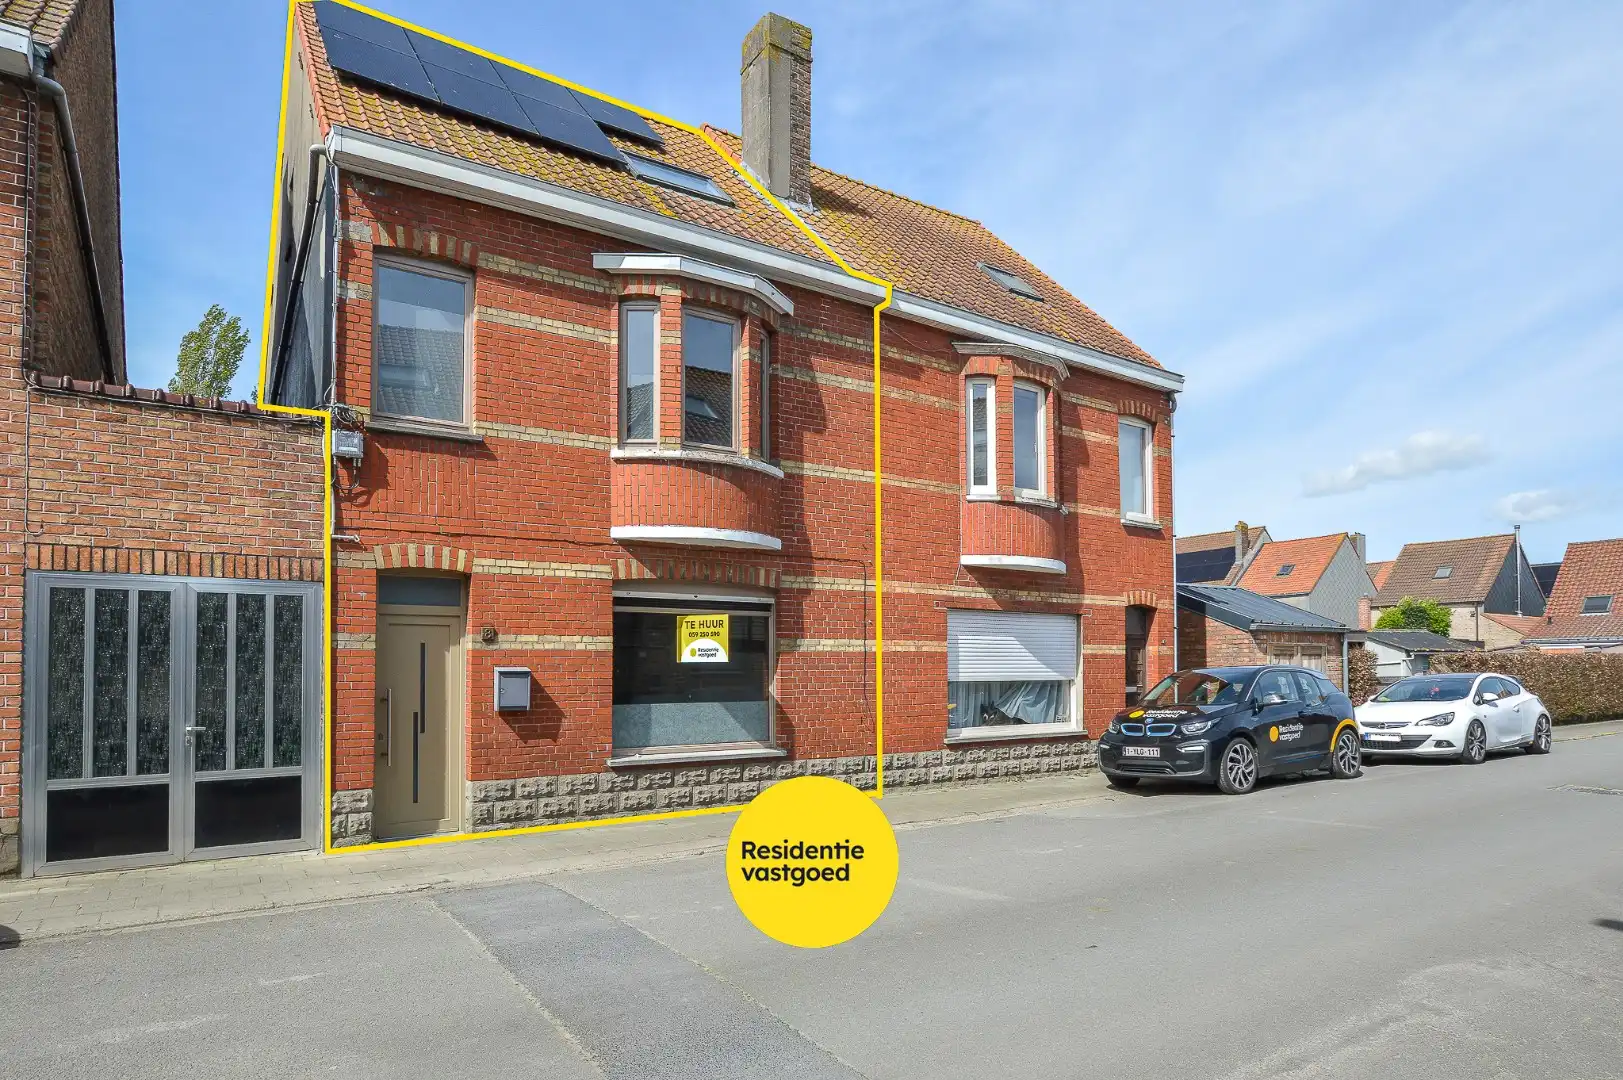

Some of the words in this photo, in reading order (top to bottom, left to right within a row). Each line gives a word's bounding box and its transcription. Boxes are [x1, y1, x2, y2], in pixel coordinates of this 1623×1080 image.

[684, 620, 696, 630] TE
[698, 619, 724, 629] HUUR
[1279, 723, 1303, 733] Residentie
[1279, 731, 1301, 741] vastgoed
[1126, 748, 1159, 756] 1-YLG-111
